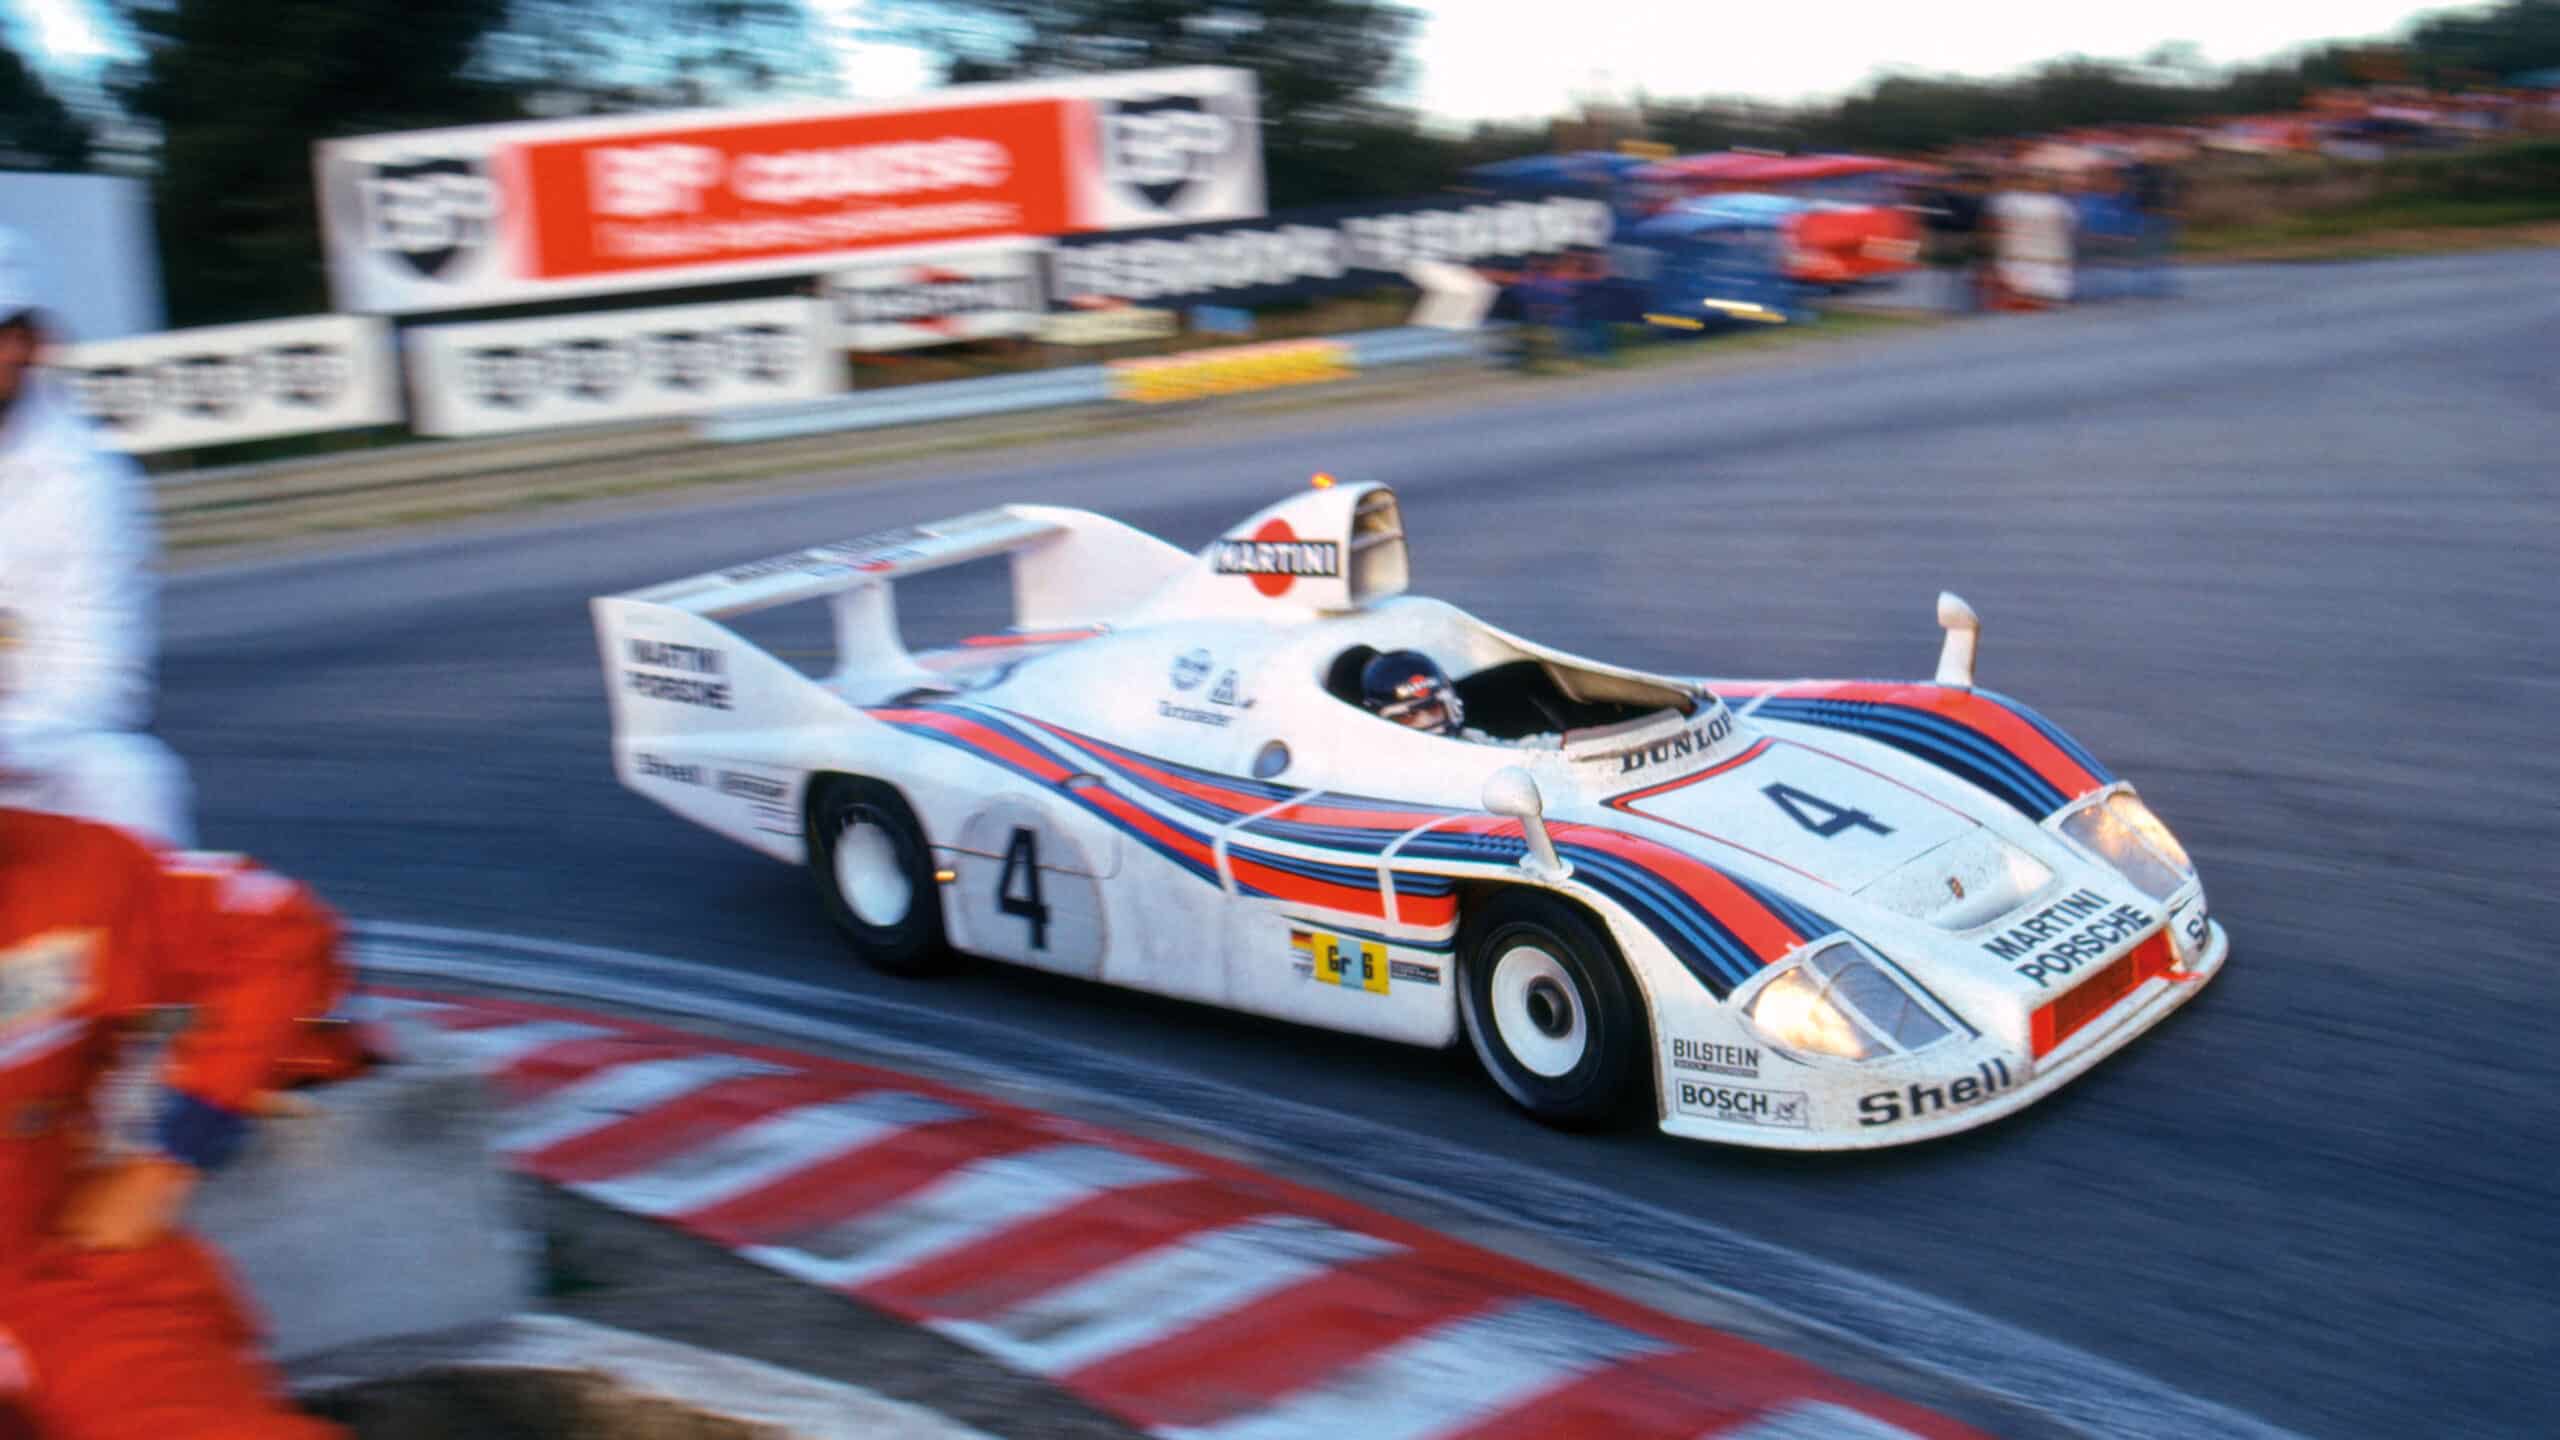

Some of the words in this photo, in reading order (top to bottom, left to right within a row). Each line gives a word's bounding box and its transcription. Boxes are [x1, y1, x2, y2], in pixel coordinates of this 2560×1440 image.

[1218, 542, 1336, 574] MARTINI
[1620, 711, 1732, 774] DUNLOP
[1760, 782, 1896, 838] 4
[998, 826, 1052, 951] 4
[1981, 888, 2111, 961] MARTINI
[2015, 903, 2155, 989] PORSCHE
[1327, 945, 1351, 975] Gr
[1361, 951, 1374, 981] 6
[1673, 1038, 1761, 1068] BILSTEIN
[1681, 1083, 1769, 1116] BOSCH
[1857, 1057, 2011, 1126] Shell
